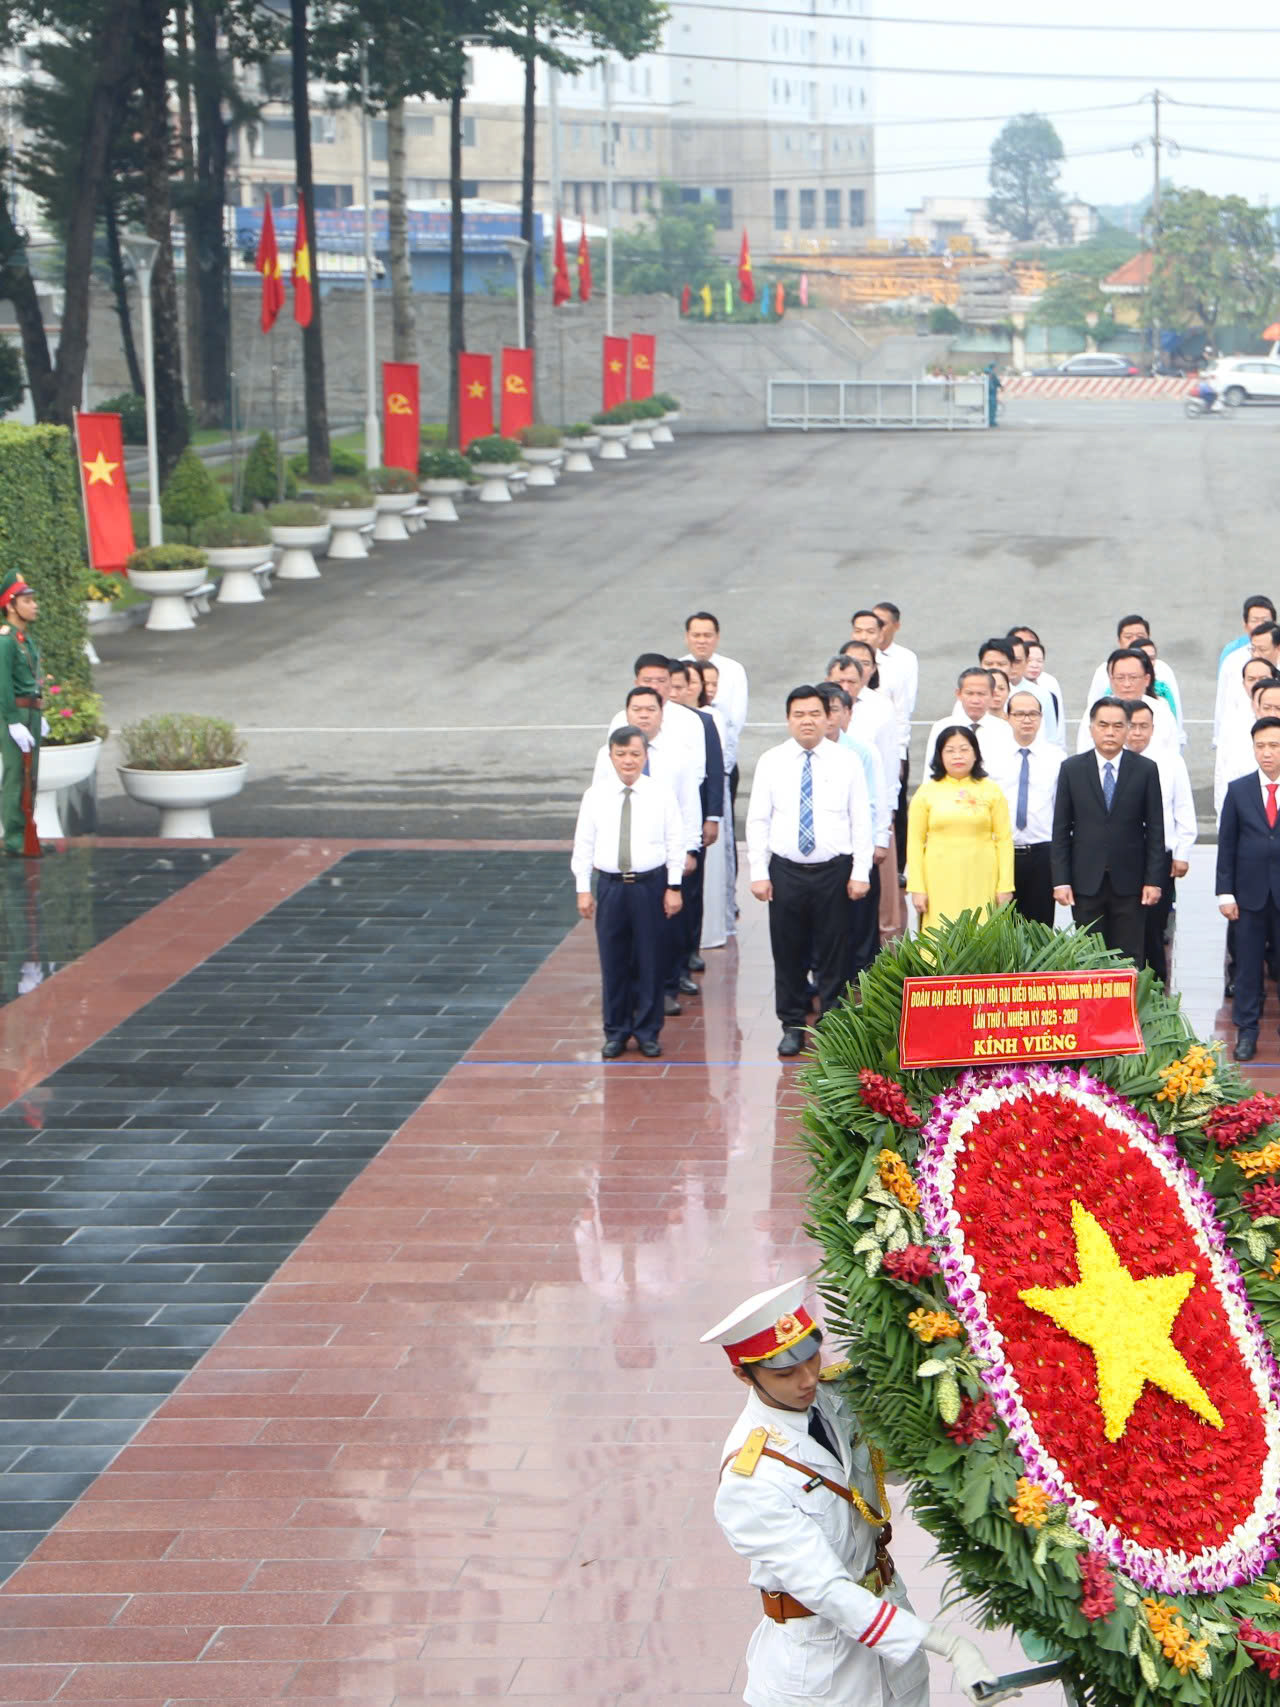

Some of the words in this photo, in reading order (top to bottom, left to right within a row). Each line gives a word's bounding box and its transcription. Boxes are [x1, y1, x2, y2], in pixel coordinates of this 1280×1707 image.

[910, 988, 931, 1008] ĐOÀN
[931, 990, 944, 1010] ĐẠI
[945, 983, 961, 1007] BIỂU
[962, 988, 973, 1009] DỰ
[973, 988, 985, 1007] ĐẠI
[986, 984, 998, 1008] HỘI
[999, 987, 1011, 1007] ĐẠI
[1012, 980, 1027, 1003] BIỂU
[1028, 980, 1047, 1002] ĐẢNG
[1047, 981, 1057, 1004] BỘ
[1057, 981, 1080, 1000] THÀNH
[1080, 978, 1093, 999] PHỐ
[1093, 978, 1102, 999] HỒ
[1113, 981, 1131, 998] MINH
[987, 1008, 1002, 1029] THỨ
[1007, 1008, 1030, 1030] NHIỆM
[1031, 1007, 1040, 1026] KỲ
[1041, 1009, 1058, 1026] 2025
[1062, 1008, 1078, 1025] 2030
[973, 1035, 1018, 1056] KÍNH
[1022, 1029, 1077, 1053] VIẾNG
